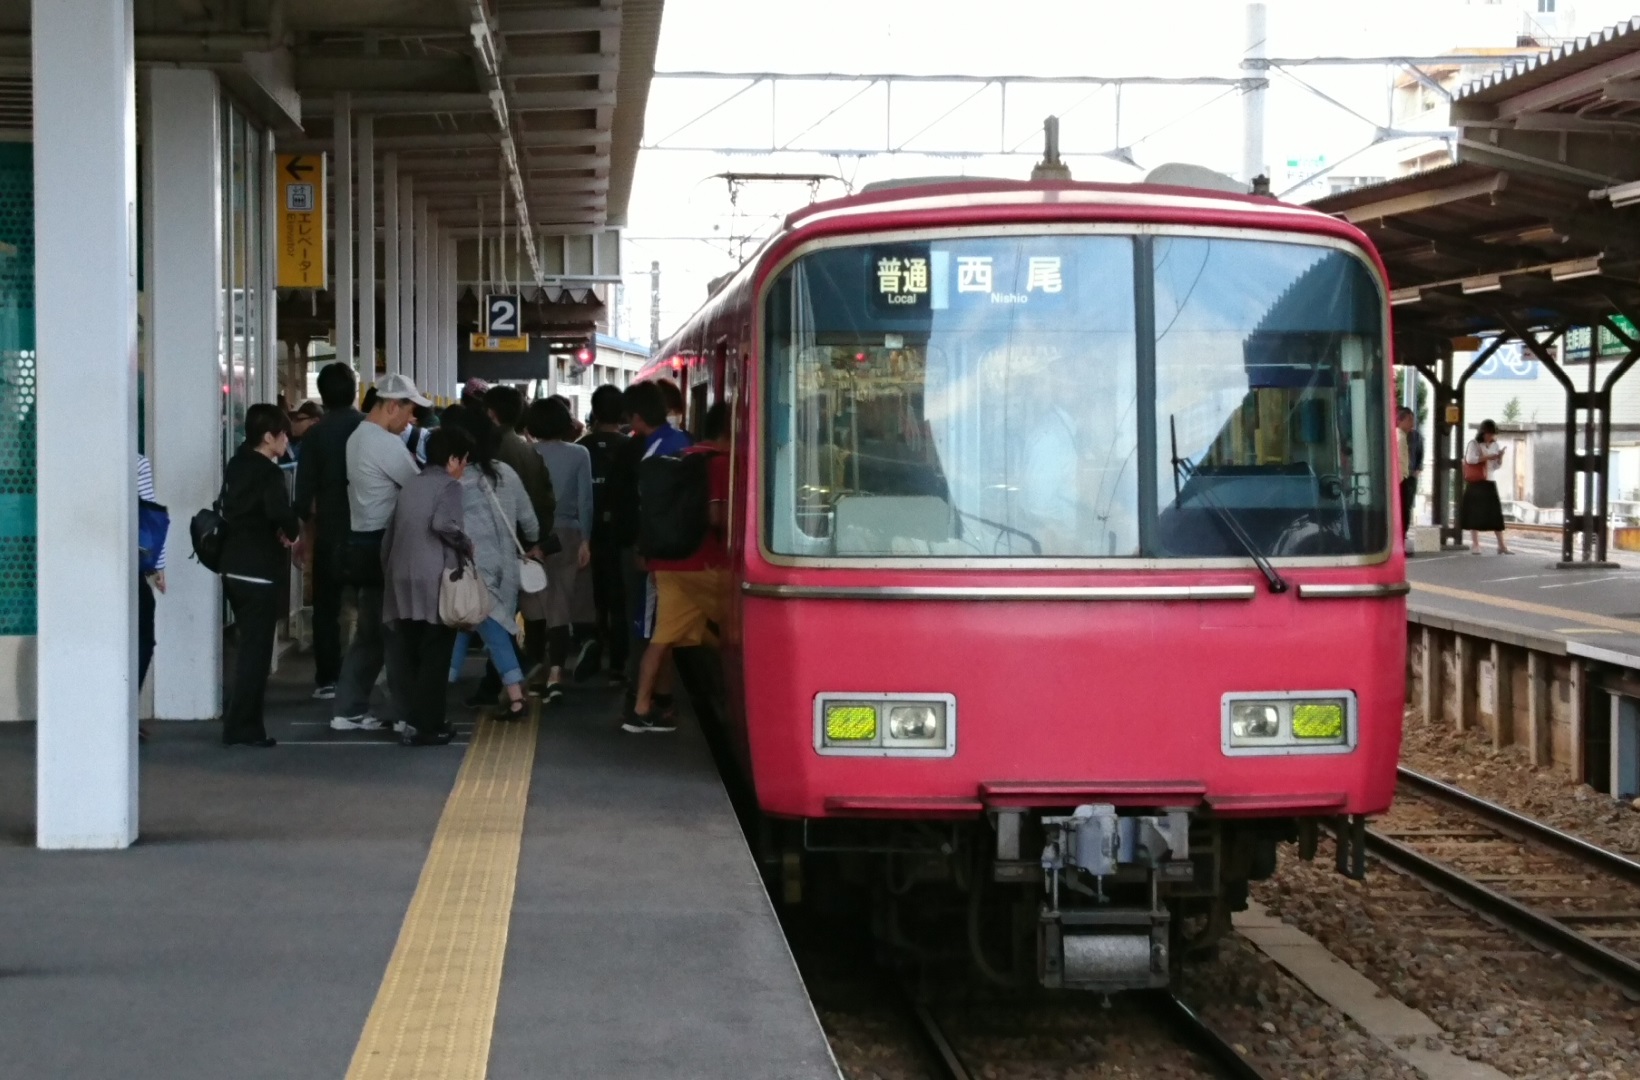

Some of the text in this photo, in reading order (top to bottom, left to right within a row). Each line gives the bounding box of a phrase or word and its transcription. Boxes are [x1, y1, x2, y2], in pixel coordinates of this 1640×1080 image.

[286, 213, 296, 257] Elevator
[298, 213, 313, 282] エレベーター
[877, 257, 927, 293] 普通
[957, 256, 1062, 293] 西尾
[491, 300, 515, 331] 2
[888, 293, 917, 304] Local
[991, 293, 1028, 304] Nishio
